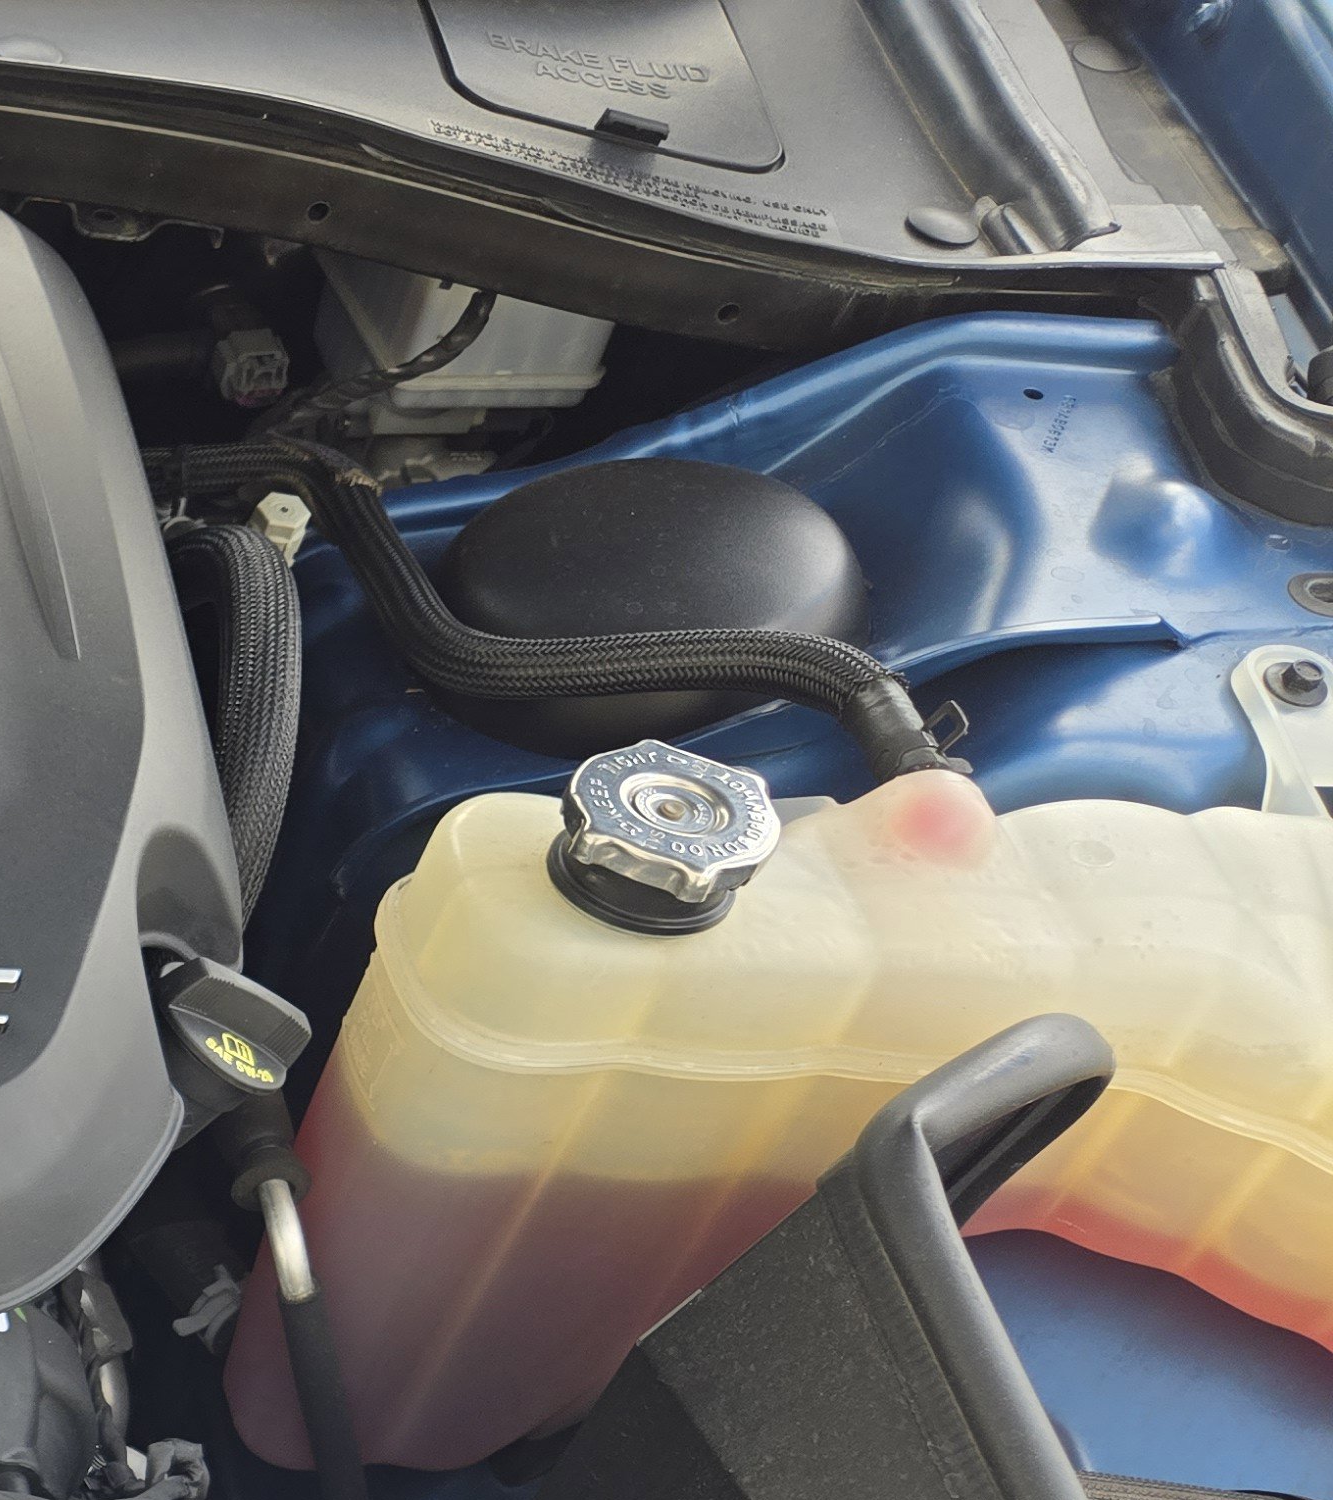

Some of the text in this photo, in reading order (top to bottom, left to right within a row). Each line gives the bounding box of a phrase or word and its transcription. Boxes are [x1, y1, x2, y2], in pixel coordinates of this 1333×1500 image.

[486, 31, 710, 83] BRAKE FLUID
[536, 61, 671, 99] ACCESS
[205, 1037, 274, 1083] SAE 5W-20
